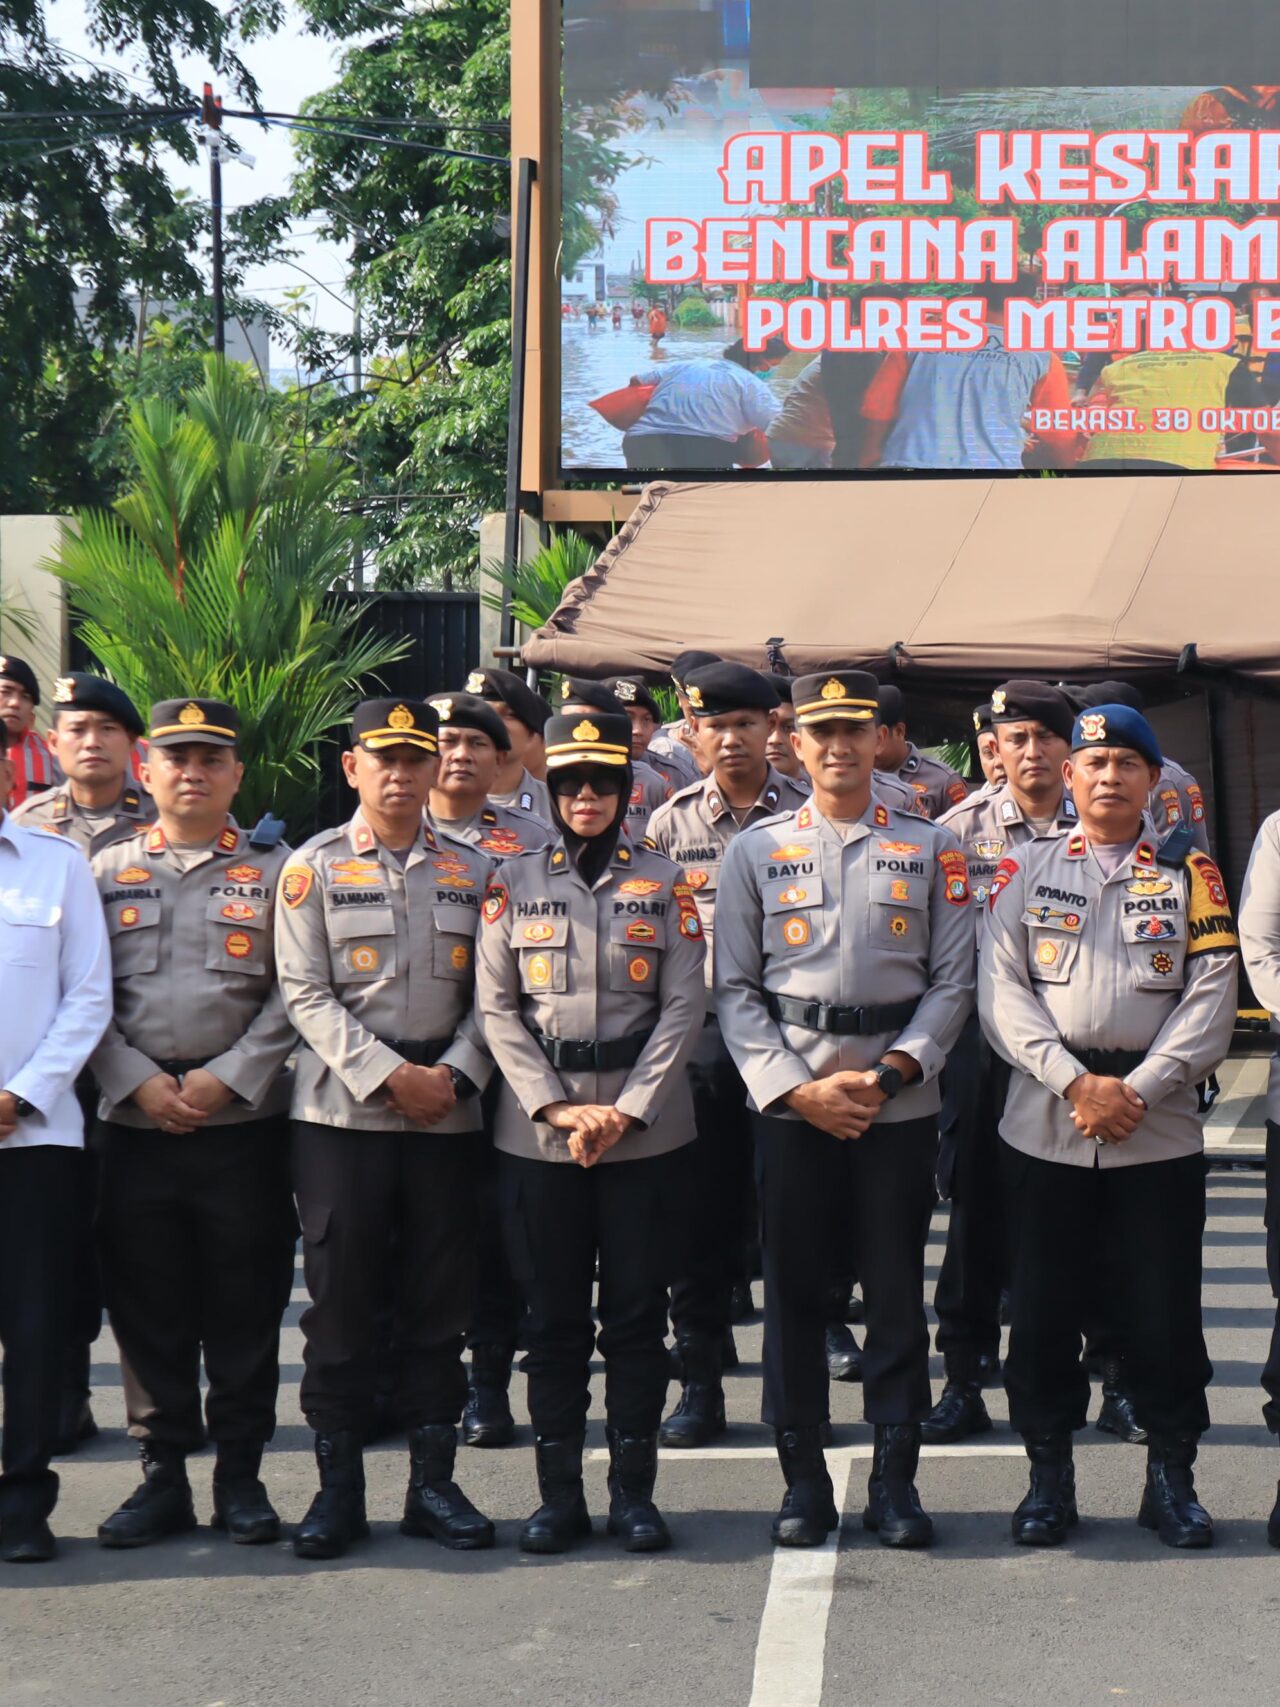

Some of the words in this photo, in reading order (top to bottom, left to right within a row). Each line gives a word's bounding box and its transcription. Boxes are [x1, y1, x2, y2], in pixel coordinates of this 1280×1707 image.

[718, 131, 952, 204] APEL
[645, 217, 1018, 283] BENCANA
[743, 297, 988, 352] POLRES
[1004, 298, 1235, 353] METRO
[1033, 408, 1146, 432] BEKASI,
[1154, 409, 1191, 432] 30
[767, 862, 814, 879] BAYU
[876, 859, 924, 876] POLRI
[209, 886, 270, 899] POLRI
[332, 892, 386, 906] BAMBANG
[436, 891, 479, 907] POLRI
[1035, 885, 1088, 908] RIYANTO
[517, 902, 567, 917] HARTI
[614, 901, 666, 917] POLRI
[1124, 897, 1179, 914] POLRI
[1188, 915, 1238, 940] DANTO
